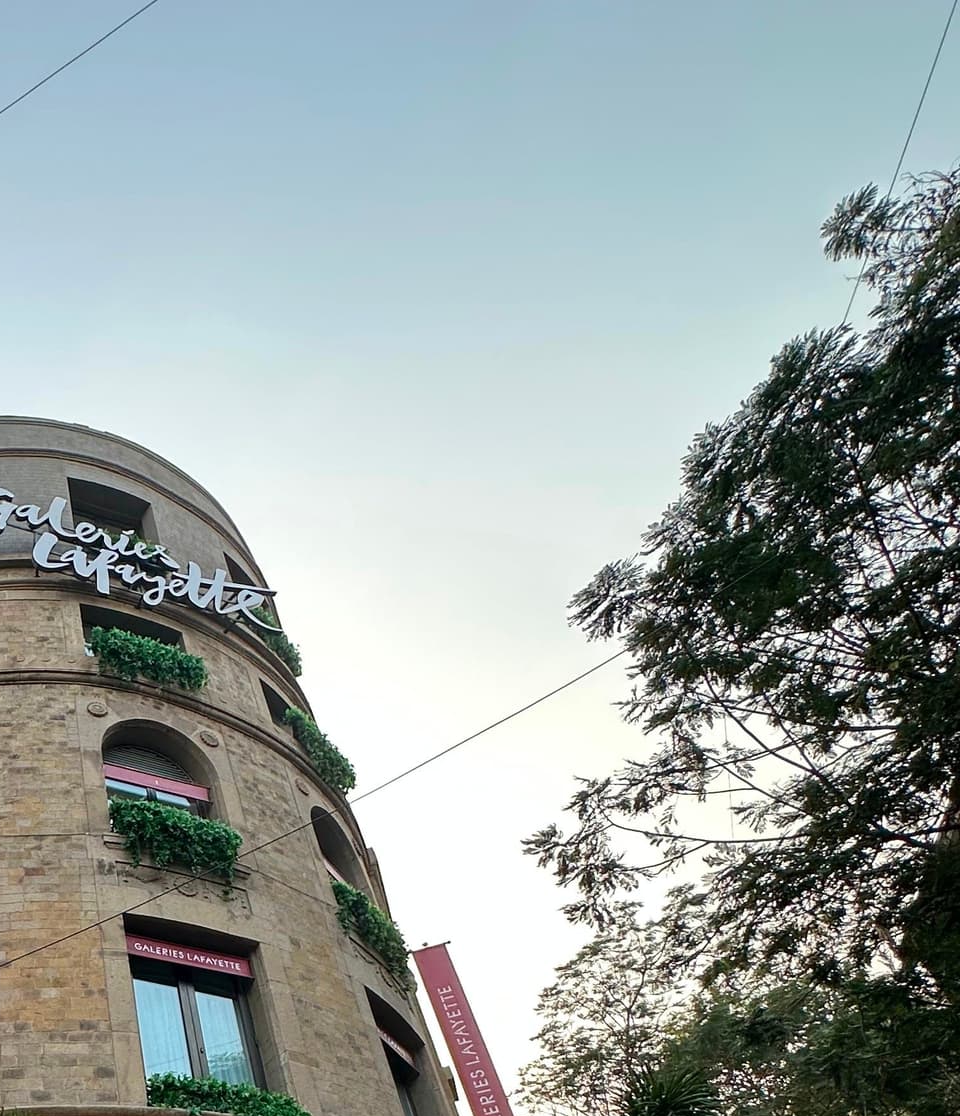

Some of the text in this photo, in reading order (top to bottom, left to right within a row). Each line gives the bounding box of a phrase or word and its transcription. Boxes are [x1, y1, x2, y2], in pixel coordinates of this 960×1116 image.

[33, 531, 284, 632] Lafayette
[134, 942, 241, 971] GALERIES LAFAYETTE
[437, 984, 482, 1067] LAFAYETTE
